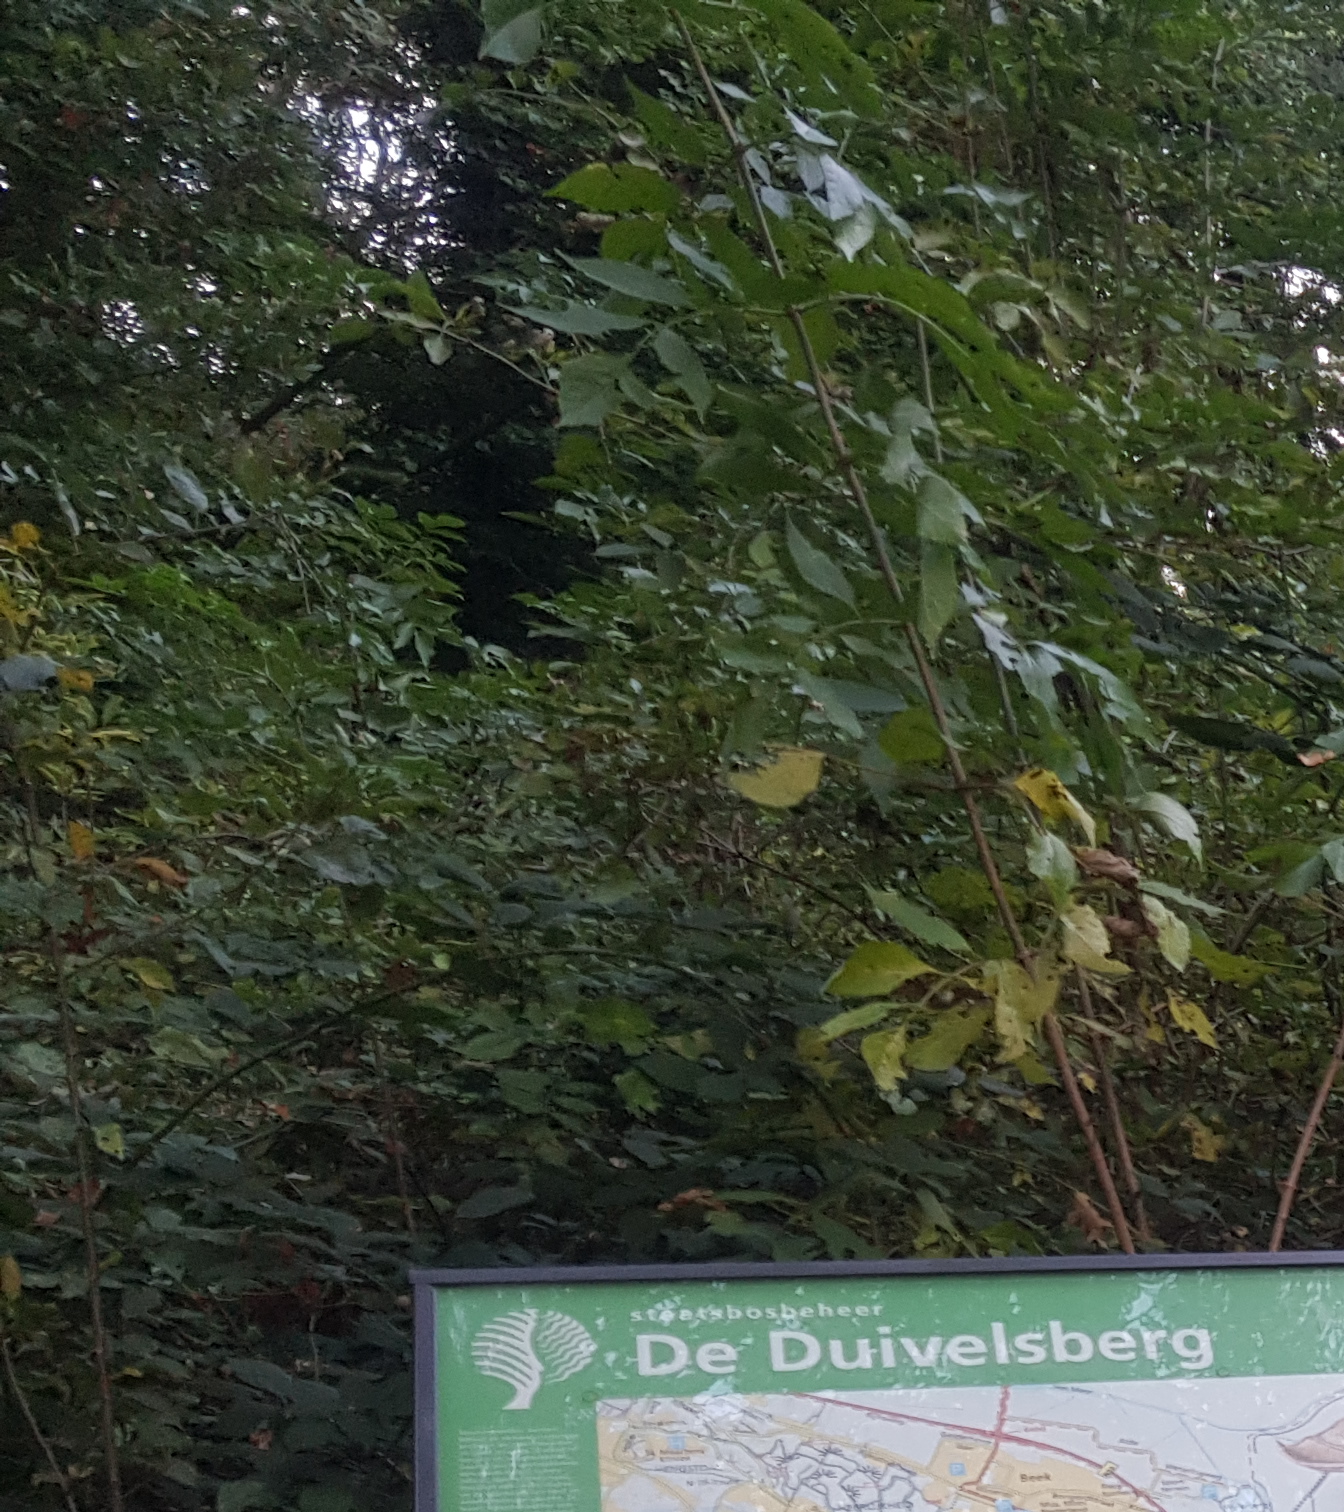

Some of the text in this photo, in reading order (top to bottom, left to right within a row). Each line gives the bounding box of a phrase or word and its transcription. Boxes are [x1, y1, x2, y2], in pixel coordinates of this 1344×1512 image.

[630, 1302, 883, 1322] staatsbosbeheer
[635, 1320, 1214, 1376] De Duivelsberg
